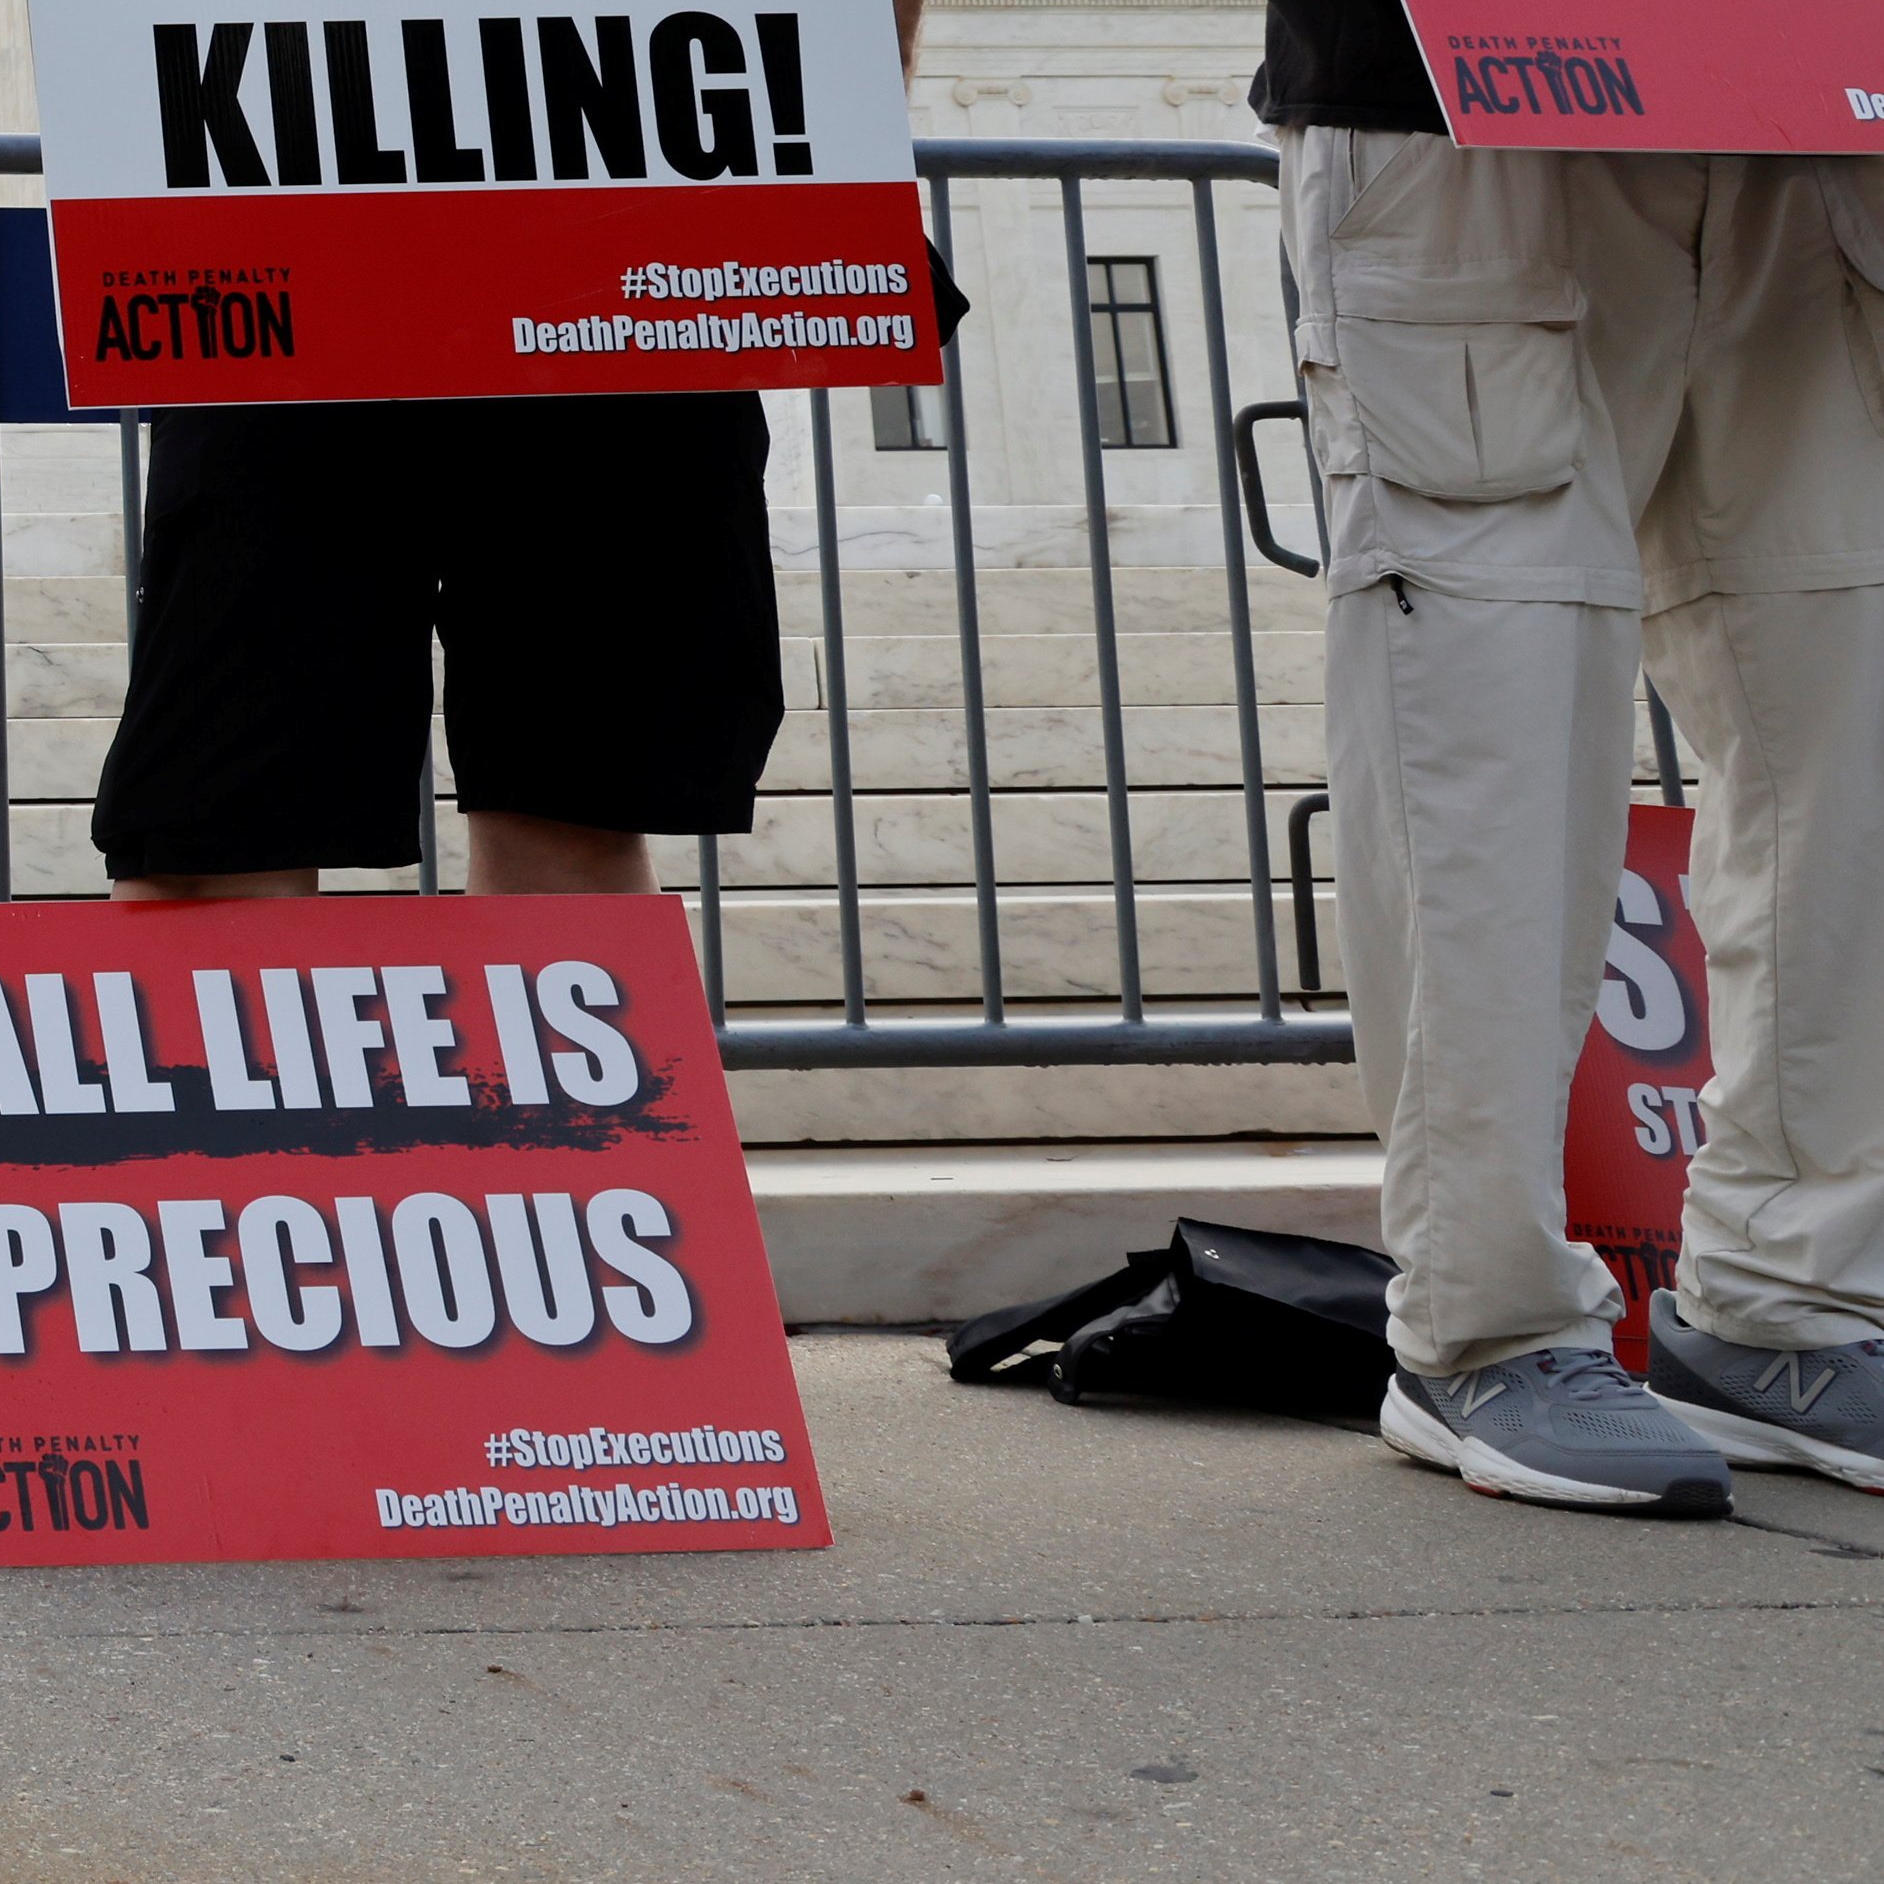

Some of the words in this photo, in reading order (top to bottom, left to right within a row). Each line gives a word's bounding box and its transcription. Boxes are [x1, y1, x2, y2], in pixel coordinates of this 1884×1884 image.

[1448, 35, 1517, 51] DEATH
[1527, 36, 1622, 53] PENALTY
[152, 10, 815, 189] KILLING!
[1454, 51, 1645, 116] ACTION
[102, 270, 176, 287] DEATH
[188, 268, 291, 285] PENALTY
[620, 259, 908, 301] #StopExecutions
[95, 286, 295, 362] ACTION
[512, 312, 915, 356] DeathPenaltyAction.org
[191, 965, 472, 1112] LIFE
[484, 960, 639, 1108] IS
[1574, 1224, 1625, 1238] DEATH
[34, 1434, 139, 1452] PENALTY
[484, 1425, 785, 1468] #StopExecutions
[376, 1484, 798, 1531] DeathPenaltyAction.org
